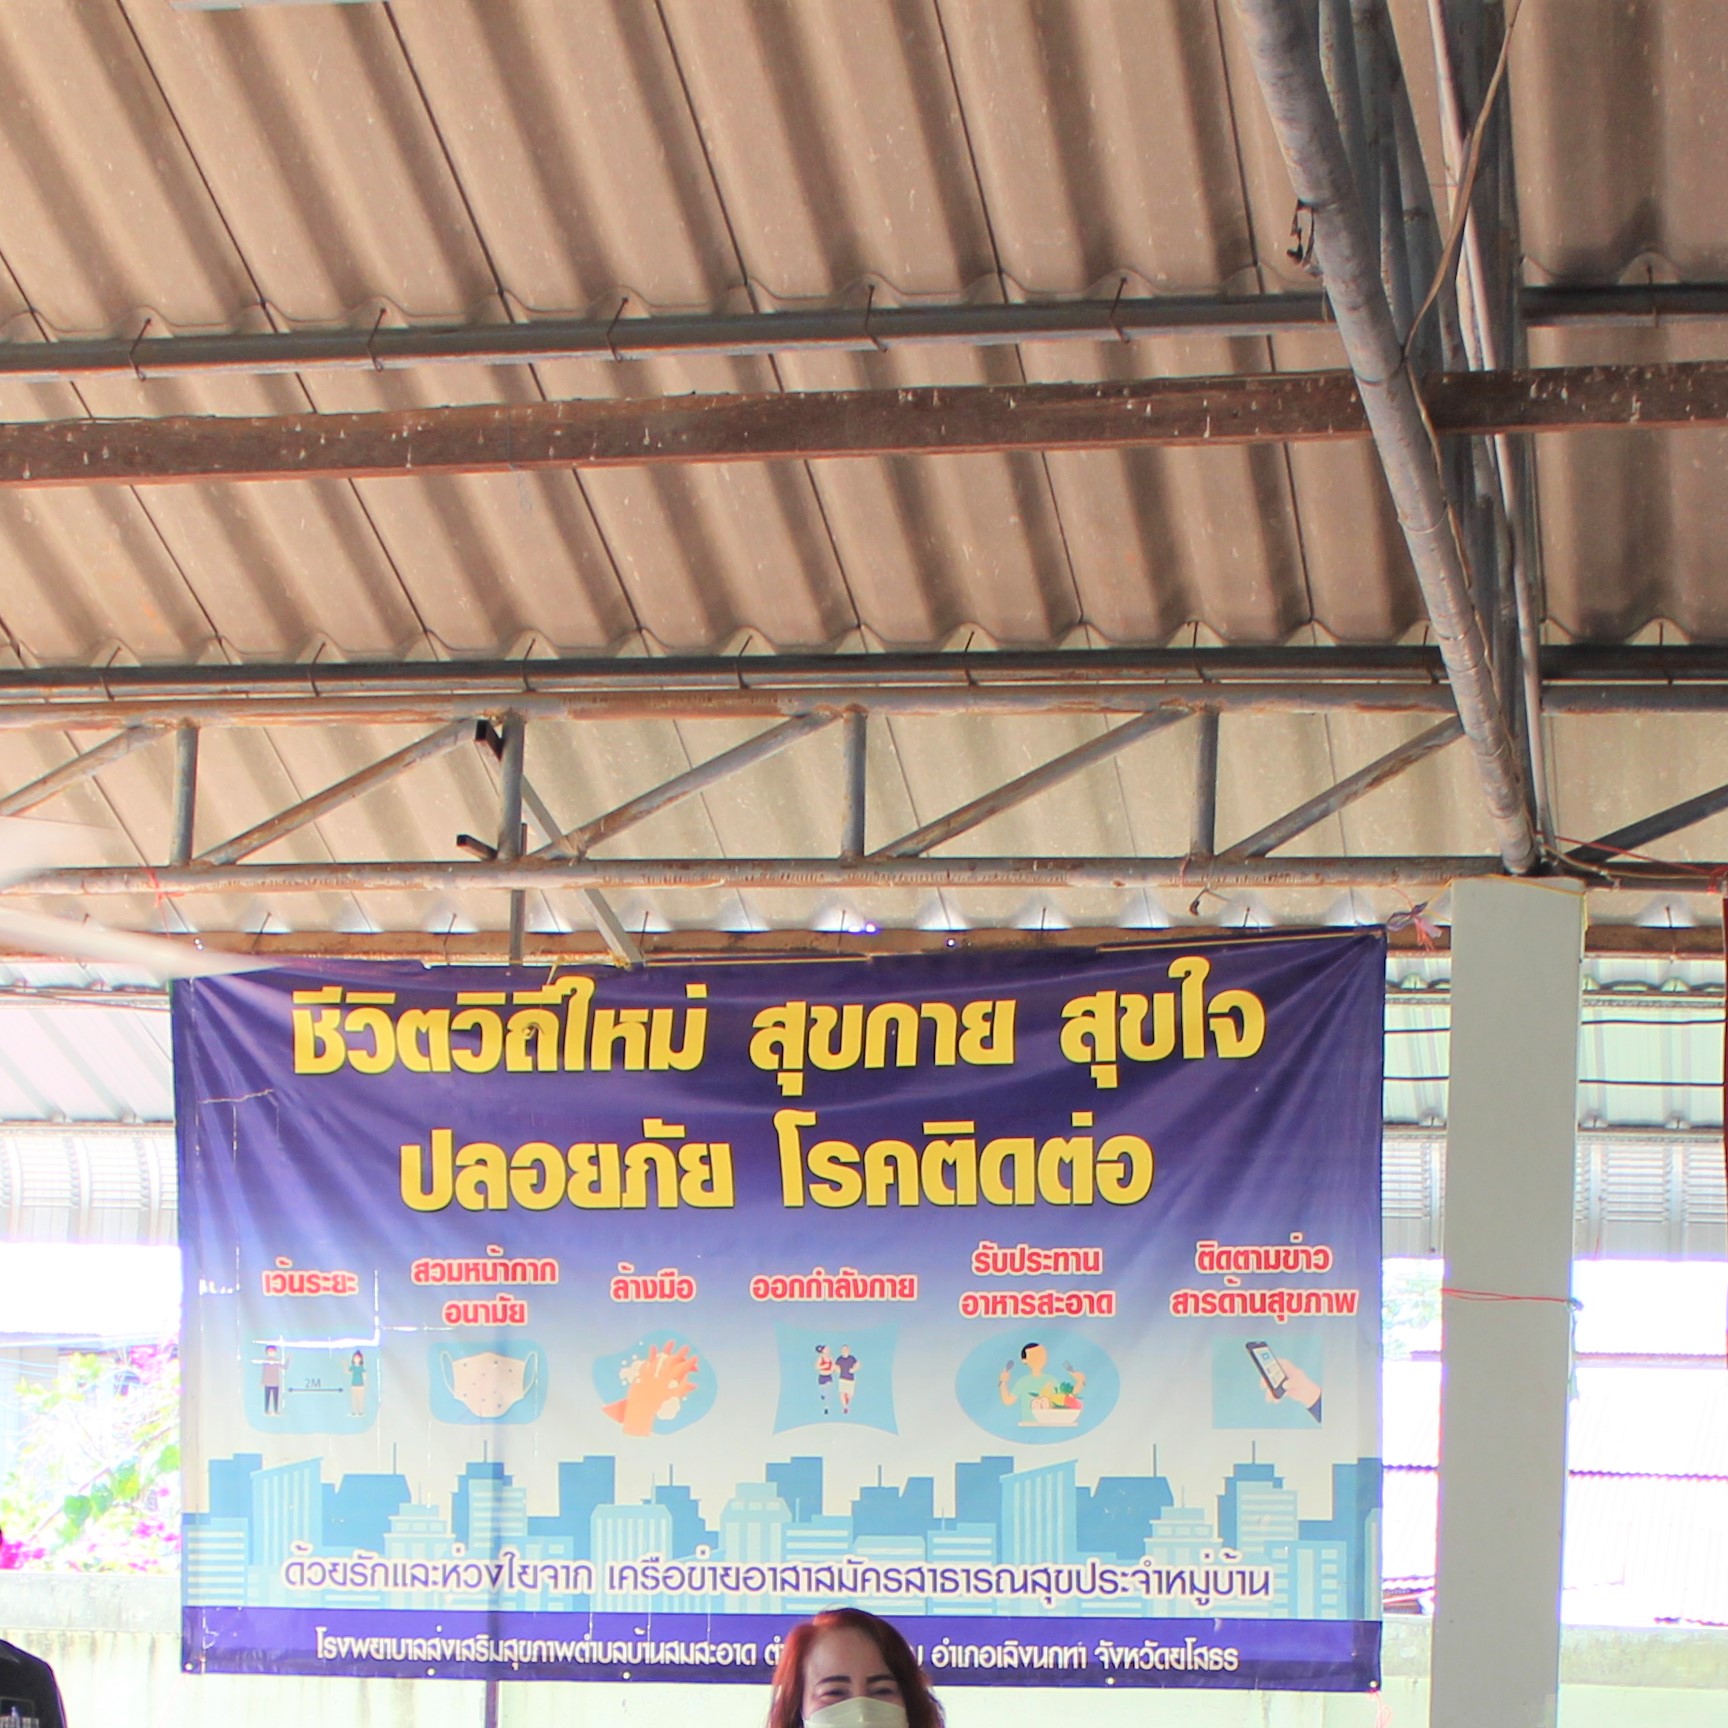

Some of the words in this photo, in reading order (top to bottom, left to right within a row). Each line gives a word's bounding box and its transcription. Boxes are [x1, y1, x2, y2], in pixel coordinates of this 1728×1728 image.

[292, 973, 708, 1076] ชีวิตวิถีใหม่
[750, 1000, 1017, 1098] สุขกาย
[1061, 957, 1267, 1090] สุขใจ
[401, 1118, 736, 1212] ปลอยภัย
[774, 1110, 1155, 1209] โรคติดต่อ
[413, 1246, 559, 1285] สวมหน้ากาก
[973, 1244, 1103, 1276] รับประทาน
[1196, 1235, 1333, 1273] ติดตามข่าว
[262, 1259, 359, 1296] เว้นระยะ
[611, 1264, 697, 1303] ล้างมือ
[751, 1269, 918, 1301] ออกกำลังกาย
[443, 1296, 528, 1327] อนามัย
[960, 1290, 1116, 1318] อาหารสะอาด
[1171, 1278, 1359, 1324] สารด้านสุขภาพ
[305, 1378, 322, 1389] 2M
[284, 1543, 593, 1591] ด้วยรักและห่วงใยจาก
[607, 1544, 1272, 1605] เครือข่ายอาสาสมัครสาธารณสุขประจำหมู่บ้าน
[315, 1625, 758, 1669] โรงพยาบาลส่งเสริมสุขภาพตำบลบ้านสมสะอาด
[1094, 1636, 1241, 1672] จังหวัดยโสธร
